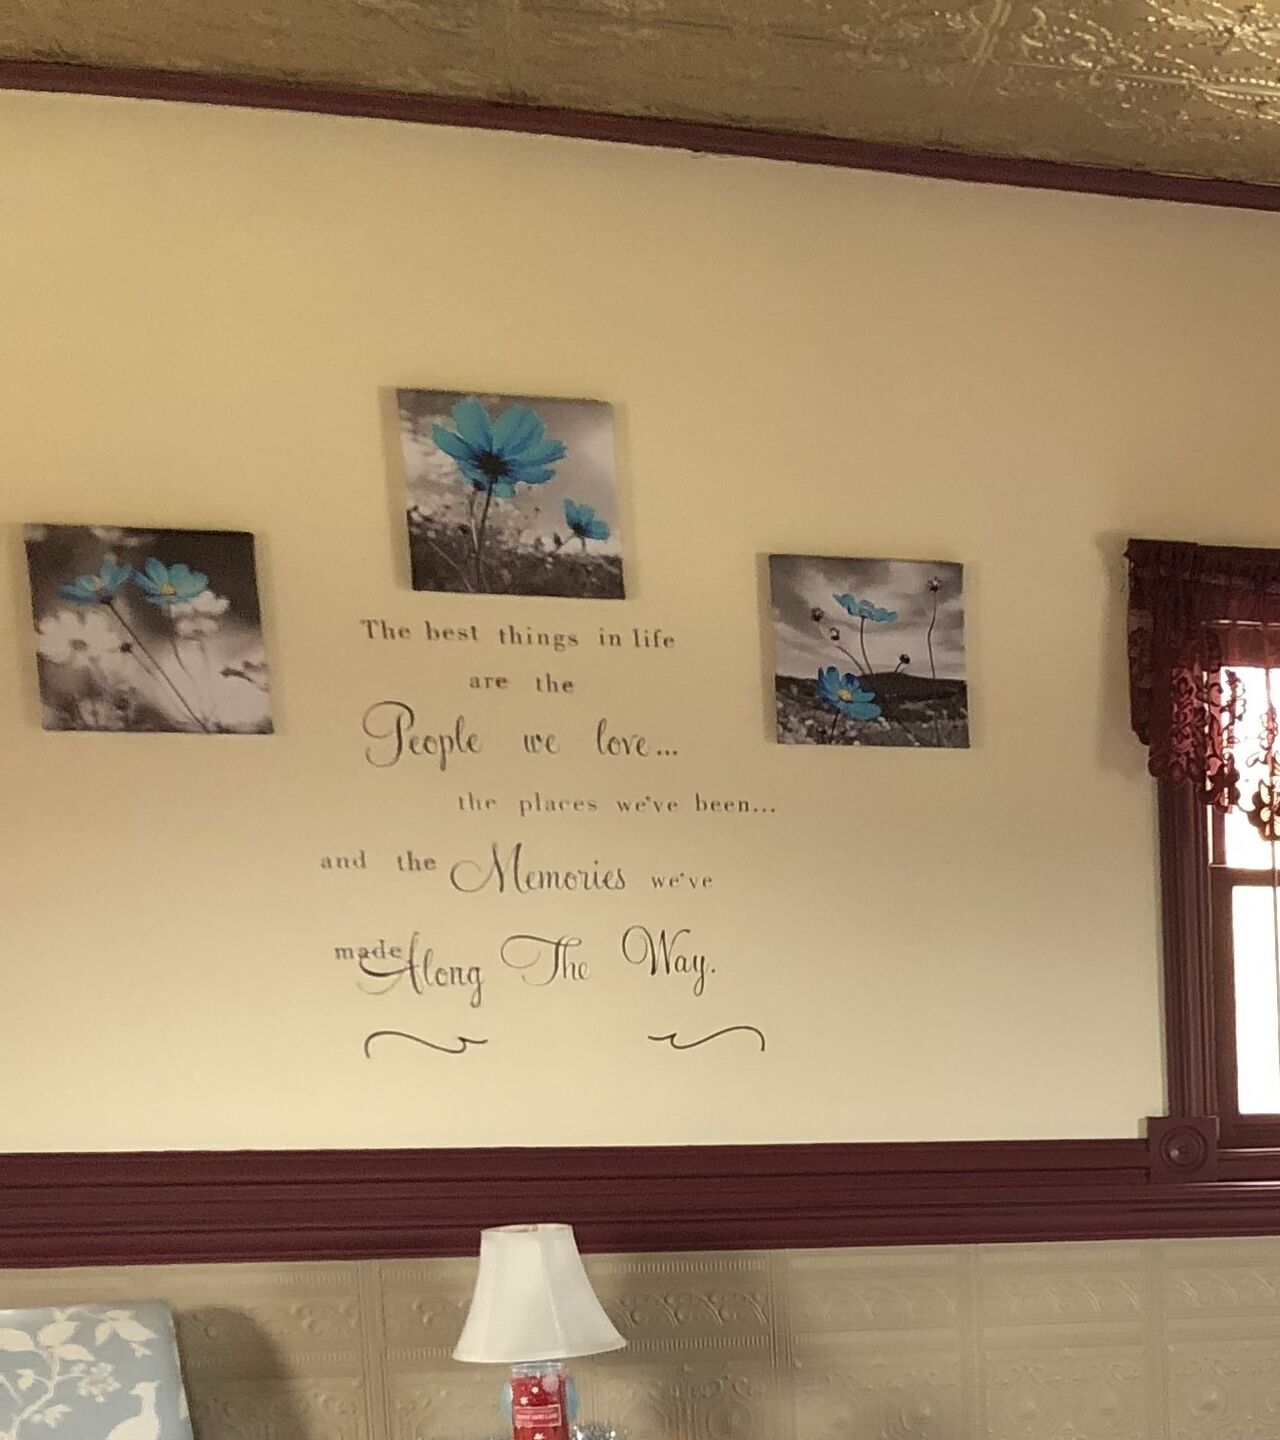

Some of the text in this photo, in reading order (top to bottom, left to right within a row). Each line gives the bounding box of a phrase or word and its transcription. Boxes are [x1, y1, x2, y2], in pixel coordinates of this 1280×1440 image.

[359, 619, 677, 652] The best things in life
[469, 673, 576, 694] are the
[362, 700, 482, 772] People
[523, 733, 560, 754] we
[457, 793, 497, 812] the
[519, 794, 598, 817] places
[616, 795, 679, 814] we've
[320, 841, 713, 894] and the Memories we've
[334, 925, 716, 1009] made Along The Way.
